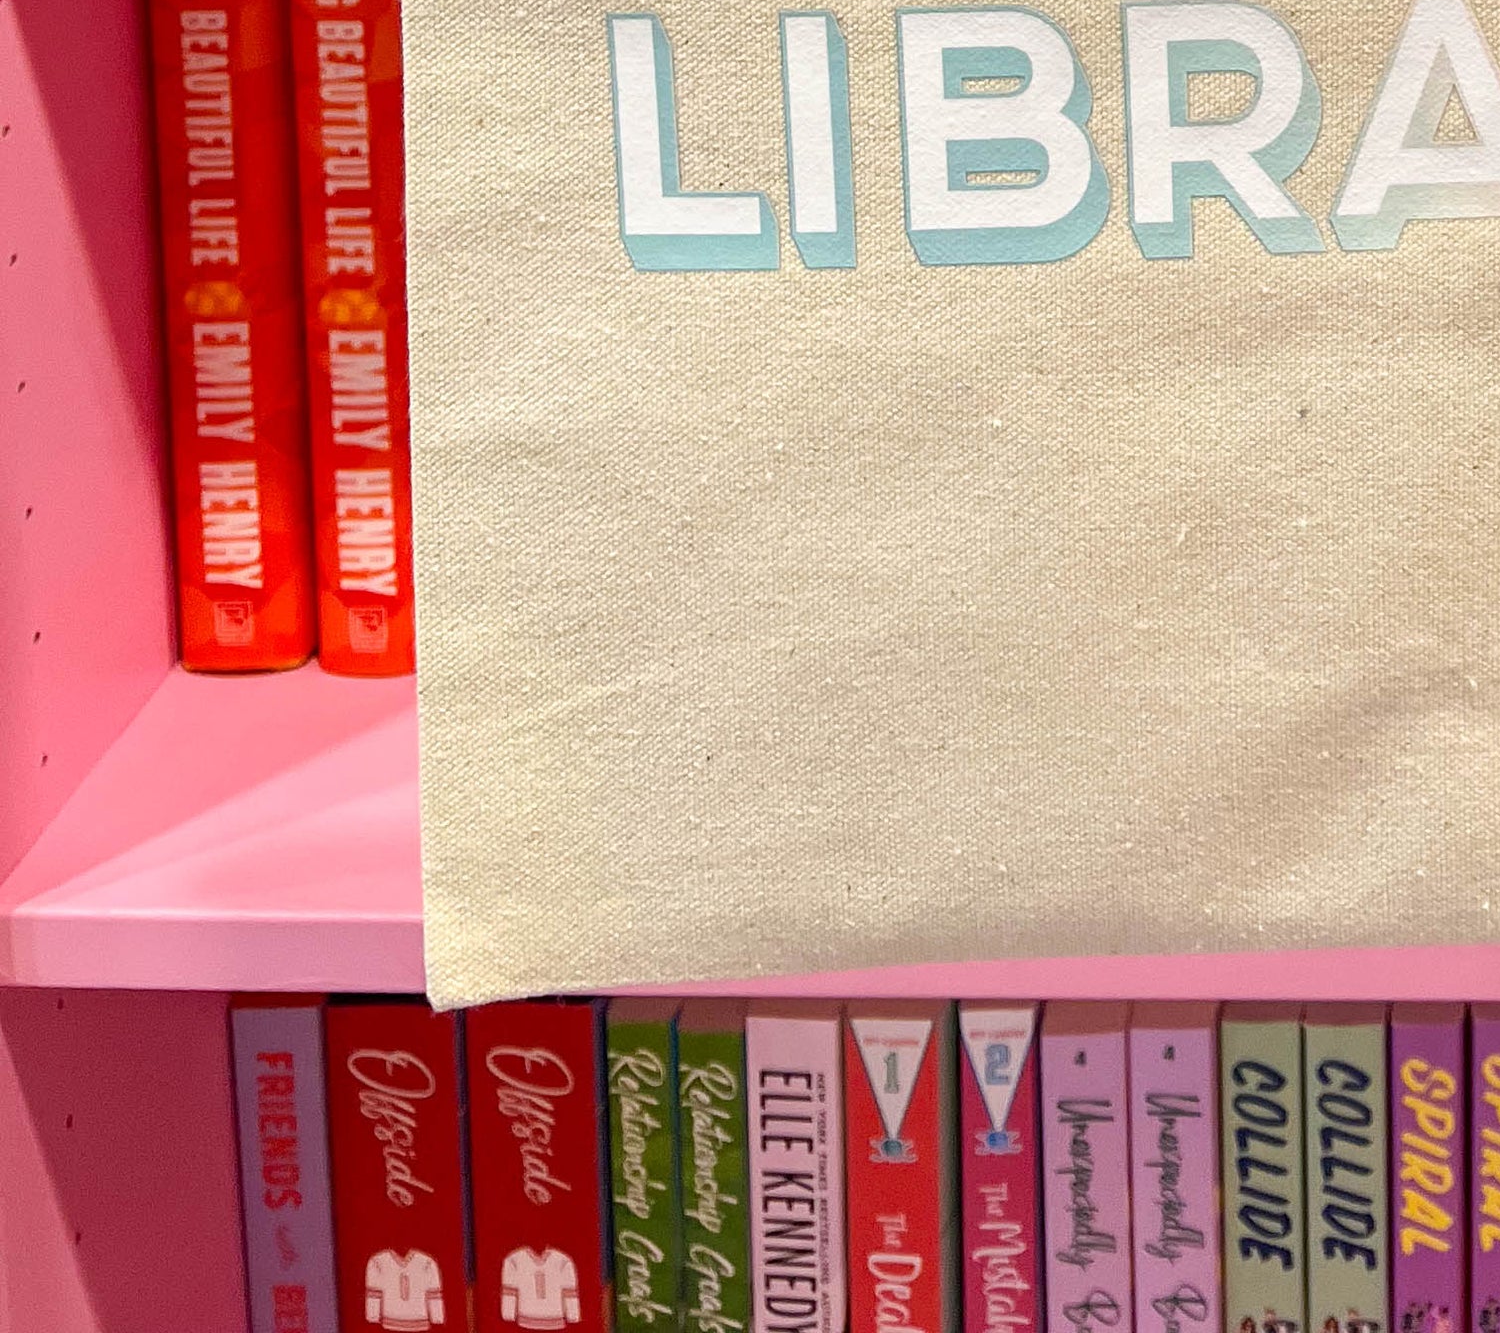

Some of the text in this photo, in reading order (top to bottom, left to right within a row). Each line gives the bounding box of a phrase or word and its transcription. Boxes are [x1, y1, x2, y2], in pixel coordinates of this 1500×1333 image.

[181, 10, 235, 188] BEAUTIFUL
[317, 20, 371, 198] BEAUTIFUL
[188, 199, 239, 266] LIFE
[325, 206, 375, 276] LIFE
[193, 321, 263, 589] EMILY HENRY
[329, 329, 397, 597] EMILY HENRY
[256, 1051, 302, 1210] FRIENDS
[347, 1048, 435, 1207] Offside
[485, 1046, 574, 1206] Offside
[759, 1070, 813, 1154] ELLE
[884, 1052, 899, 1093] 1
[984, 1044, 1010, 1085] 2
[1231, 1061, 1294, 1272] COLLIDE
[1316, 1059, 1378, 1273] COLLIDE
[1400, 1058, 1457, 1257] SPIRAL
